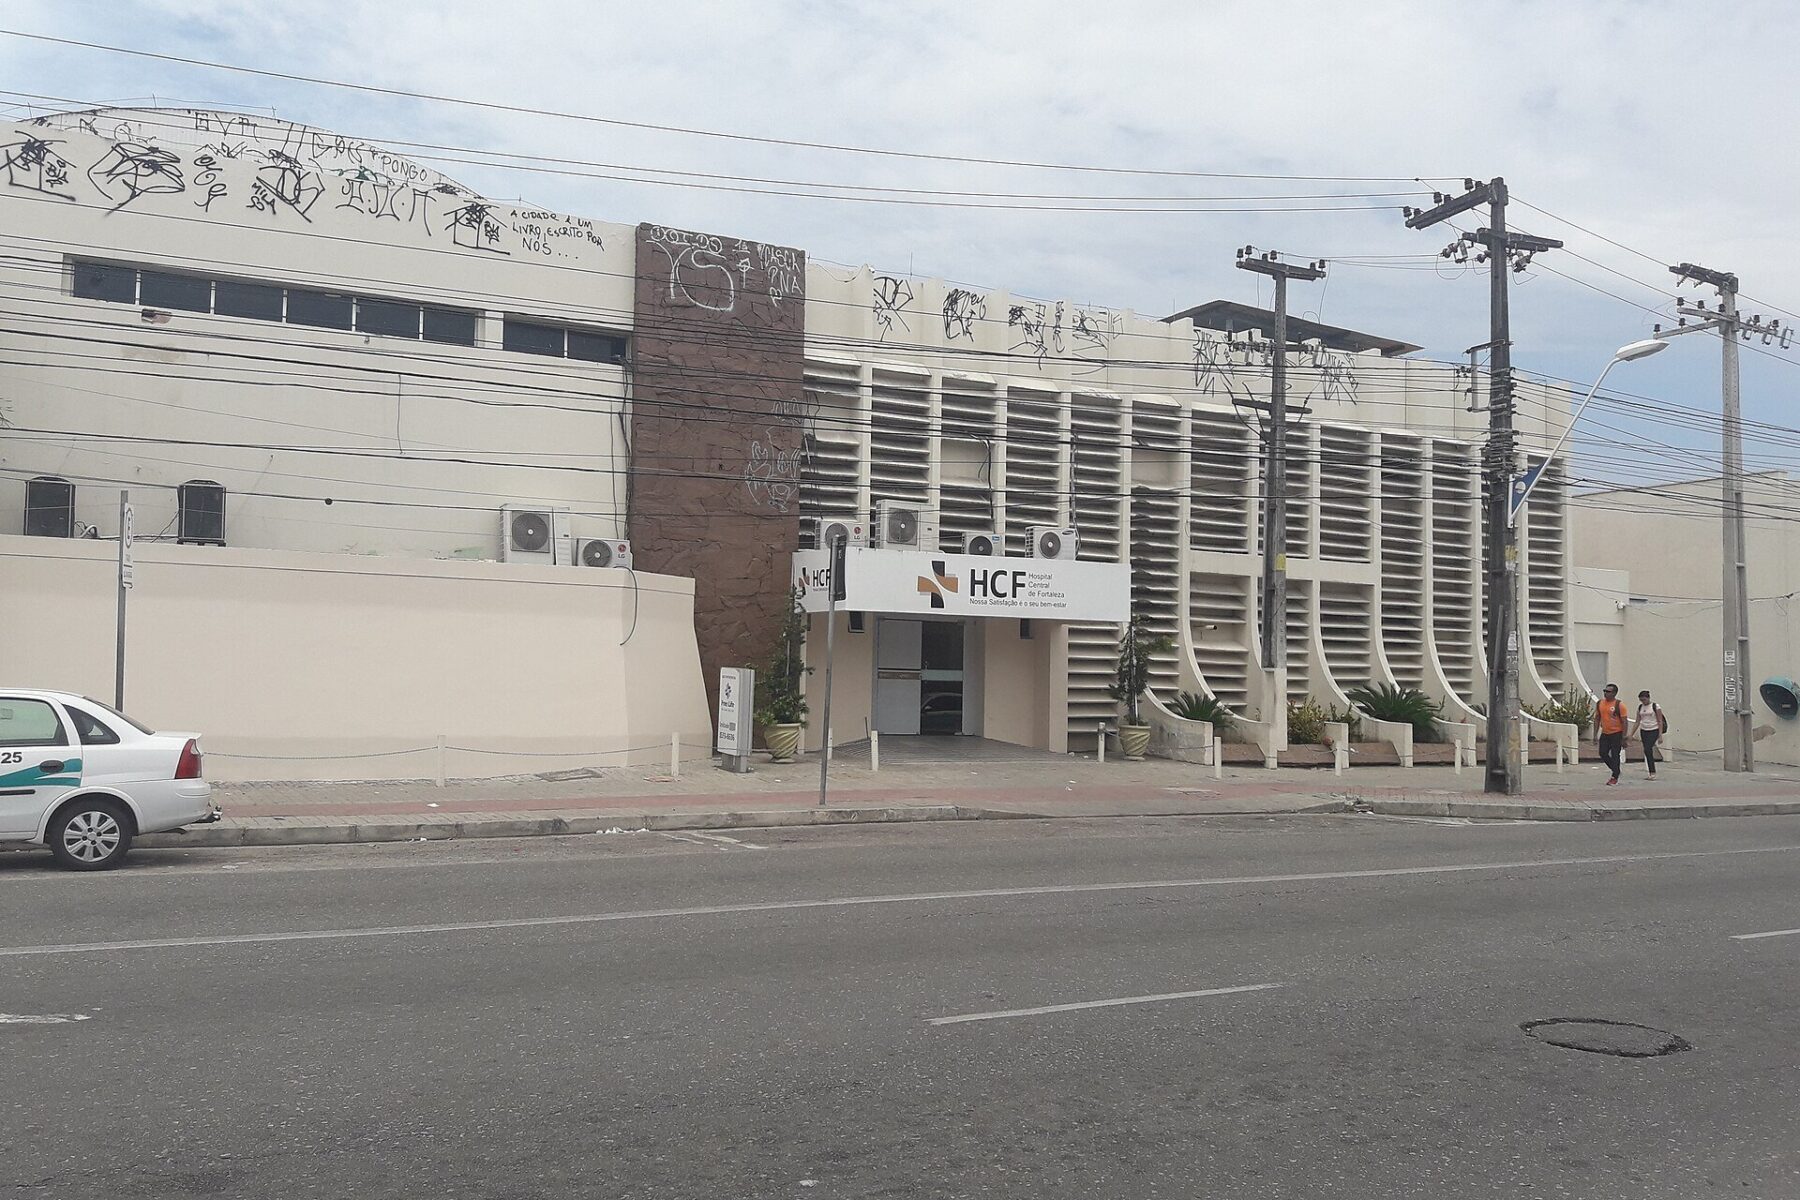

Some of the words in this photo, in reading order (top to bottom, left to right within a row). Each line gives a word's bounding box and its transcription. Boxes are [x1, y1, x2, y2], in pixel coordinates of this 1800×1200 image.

[1028, 573, 1053, 581] Hospital
[970, 569, 1026, 598] HCF
[1028, 581, 1050, 589] Central
[1037, 590, 1065, 598] Fortaleza
[1, 751, 23, 764] 25
